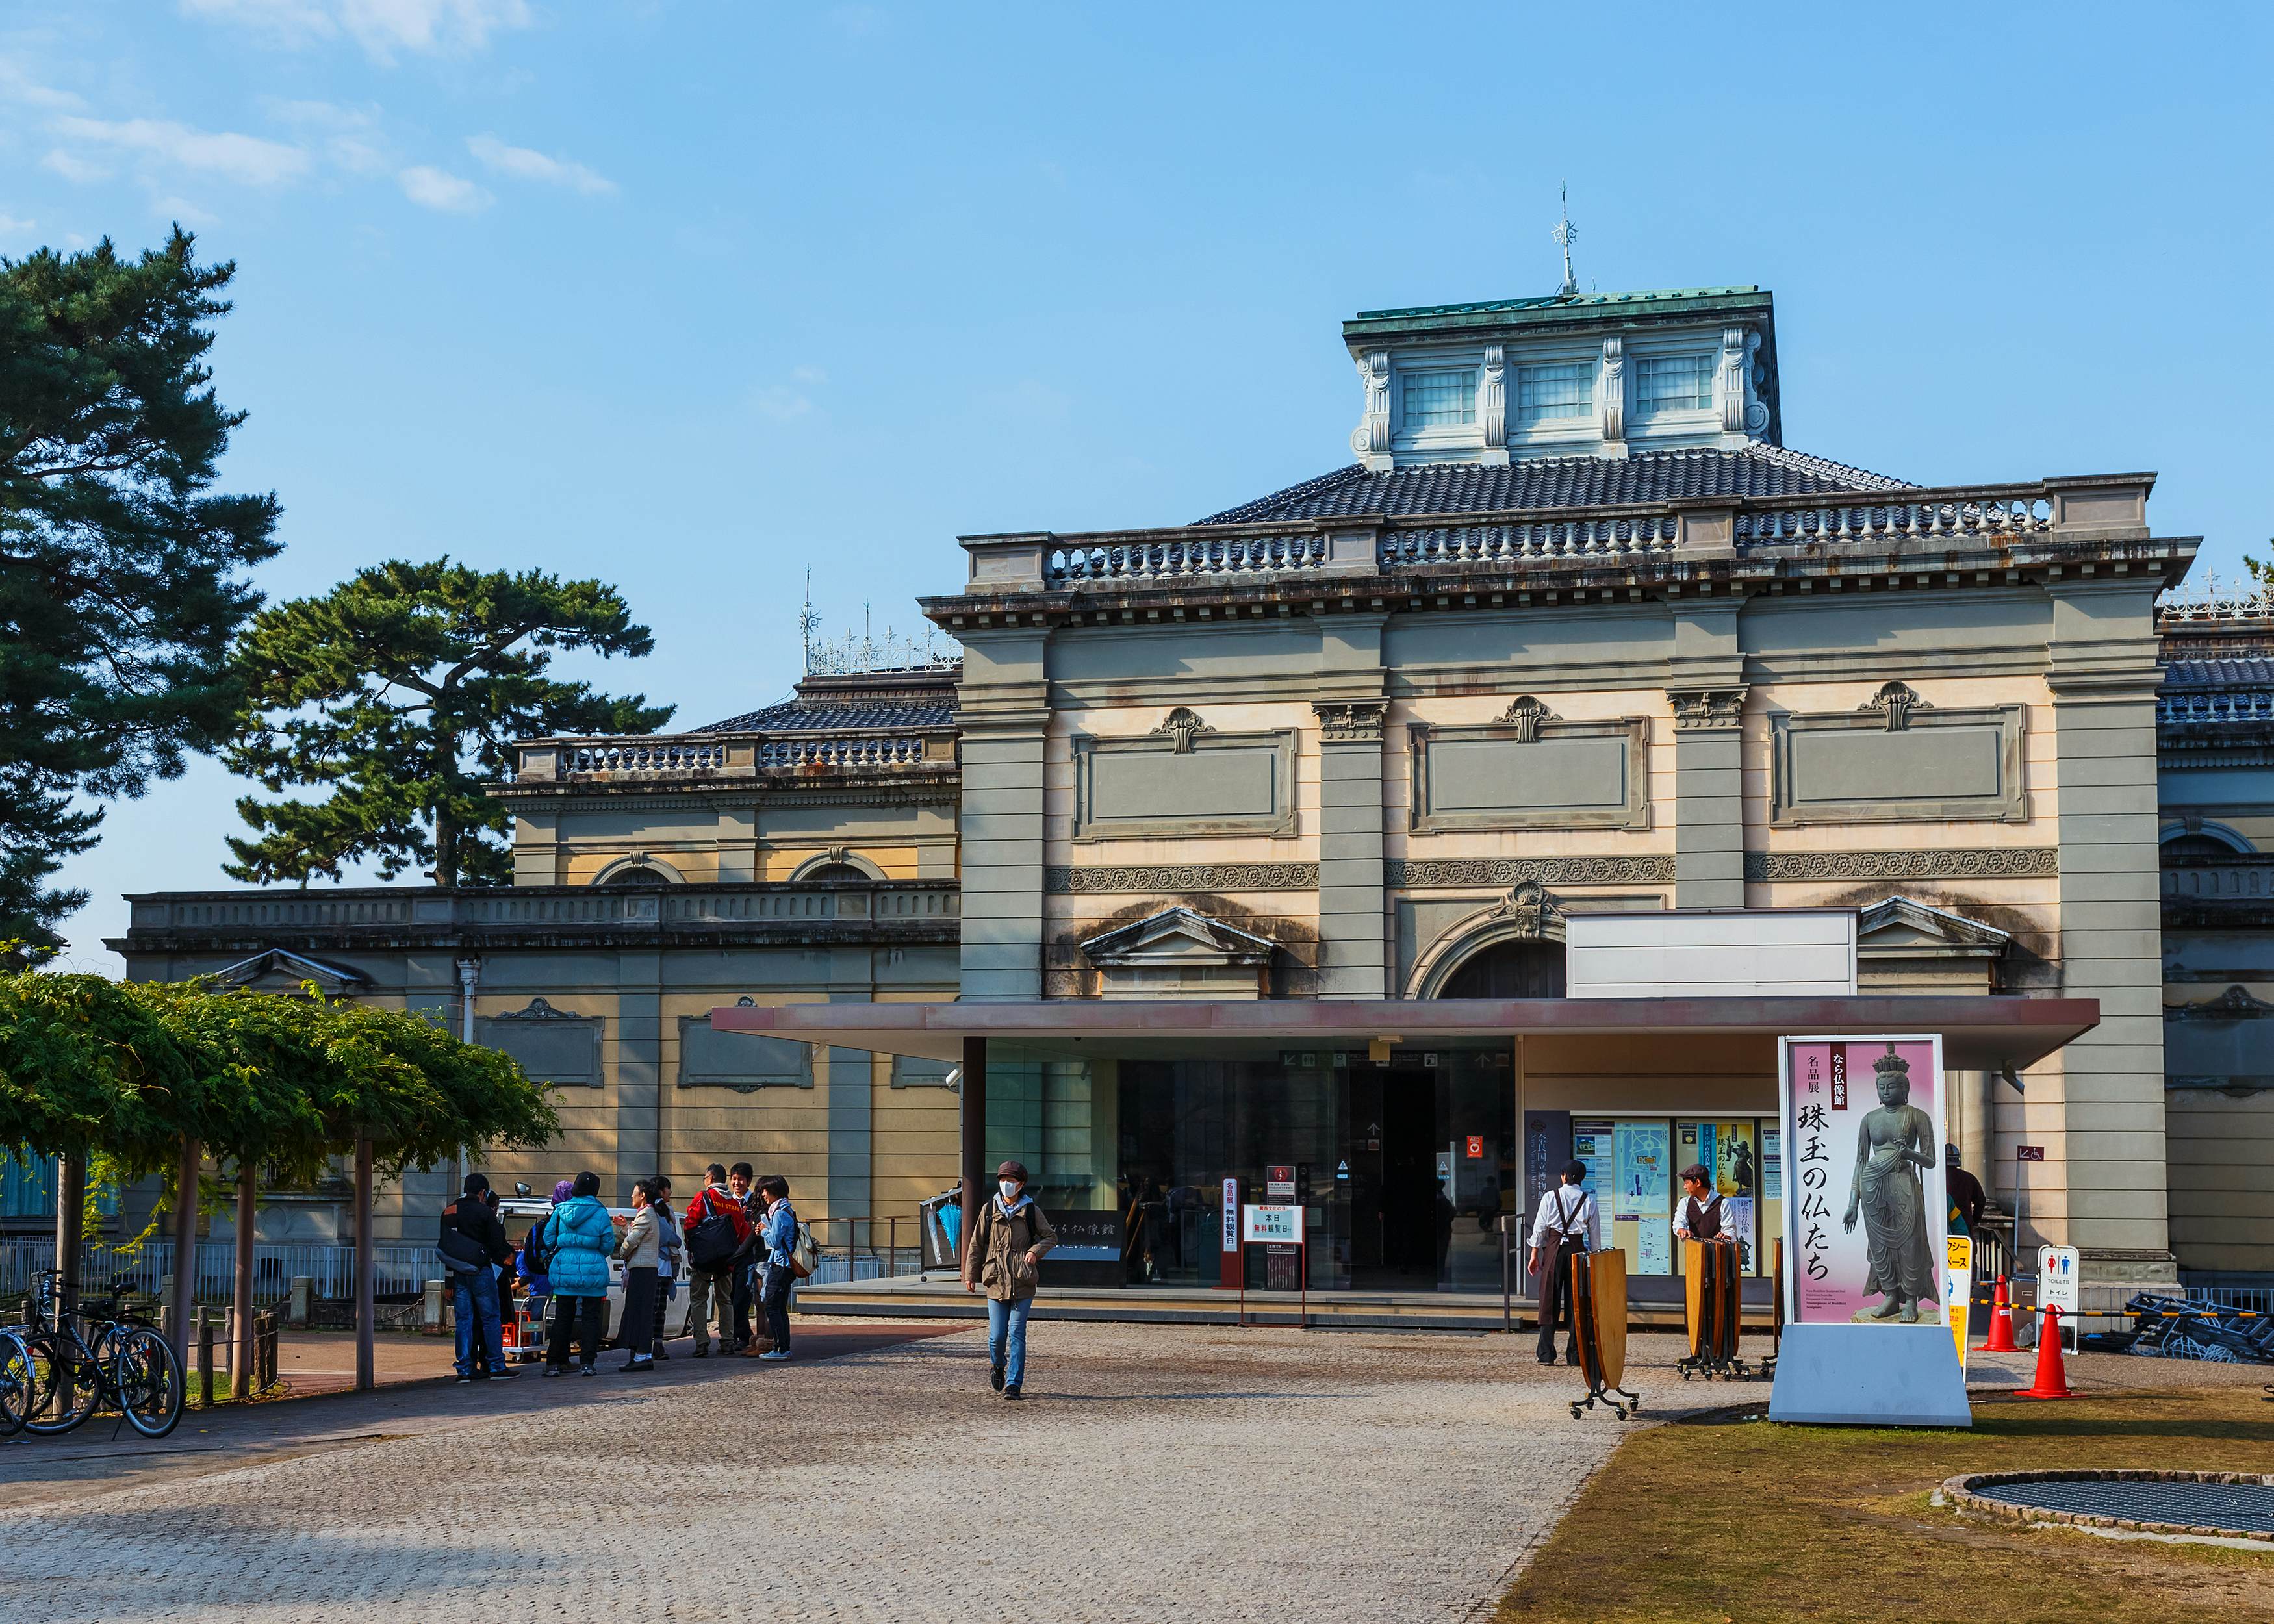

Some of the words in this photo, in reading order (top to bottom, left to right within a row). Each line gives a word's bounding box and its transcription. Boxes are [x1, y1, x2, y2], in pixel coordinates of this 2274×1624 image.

[1808, 1056, 1820, 1093] 名品展
[1833, 1054, 1845, 1106] なら仏像館
[1798, 1103, 1830, 1280] 珠玉の仏たち
[1225, 1209, 1234, 1245] 無料観覧日
